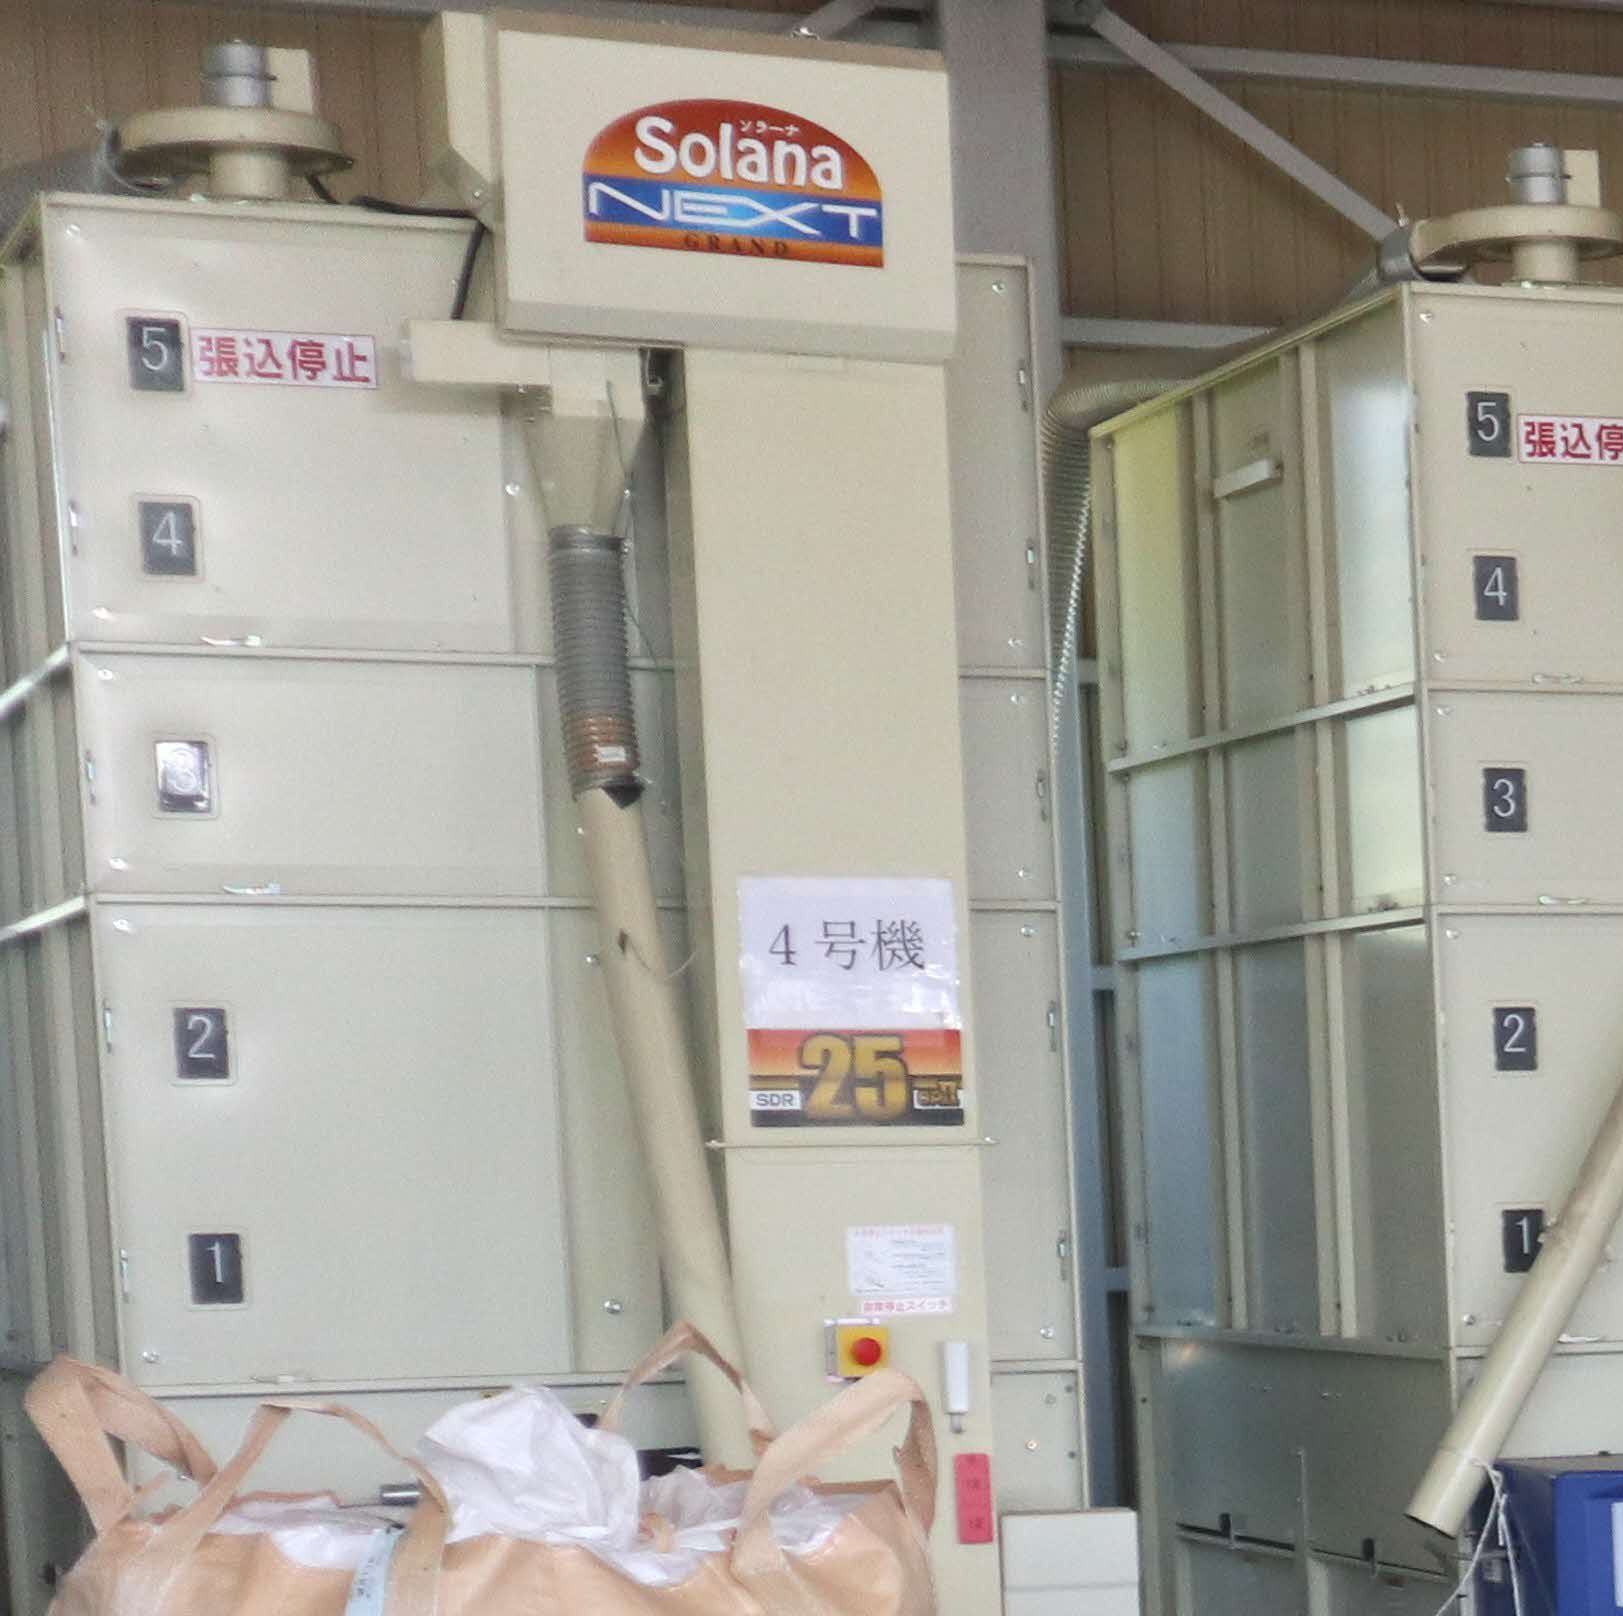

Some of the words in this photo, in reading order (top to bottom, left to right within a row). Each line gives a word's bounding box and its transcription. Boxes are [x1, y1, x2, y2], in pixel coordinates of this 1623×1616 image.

[739, 119, 800, 138] ソラーナ
[633, 115, 844, 190] Solana
[588, 181, 878, 239] NEXT
[683, 233, 790, 257] GRAND
[141, 326, 168, 371] 5
[198, 336, 371, 383] 張込停止
[1477, 402, 1500, 441] 5
[152, 511, 183, 555] 4
[1483, 567, 1507, 606] 4
[1492, 779, 1516, 817] 3
[768, 919, 926, 971] 4号機
[186, 1015, 217, 1059] 2
[1502, 1014, 1526, 1053] 2
[797, 1031, 909, 1121] 25
[756, 1093, 795, 1107] SDR
[1516, 1217, 1530, 1254] 1
[206, 1242, 225, 1284] 1
